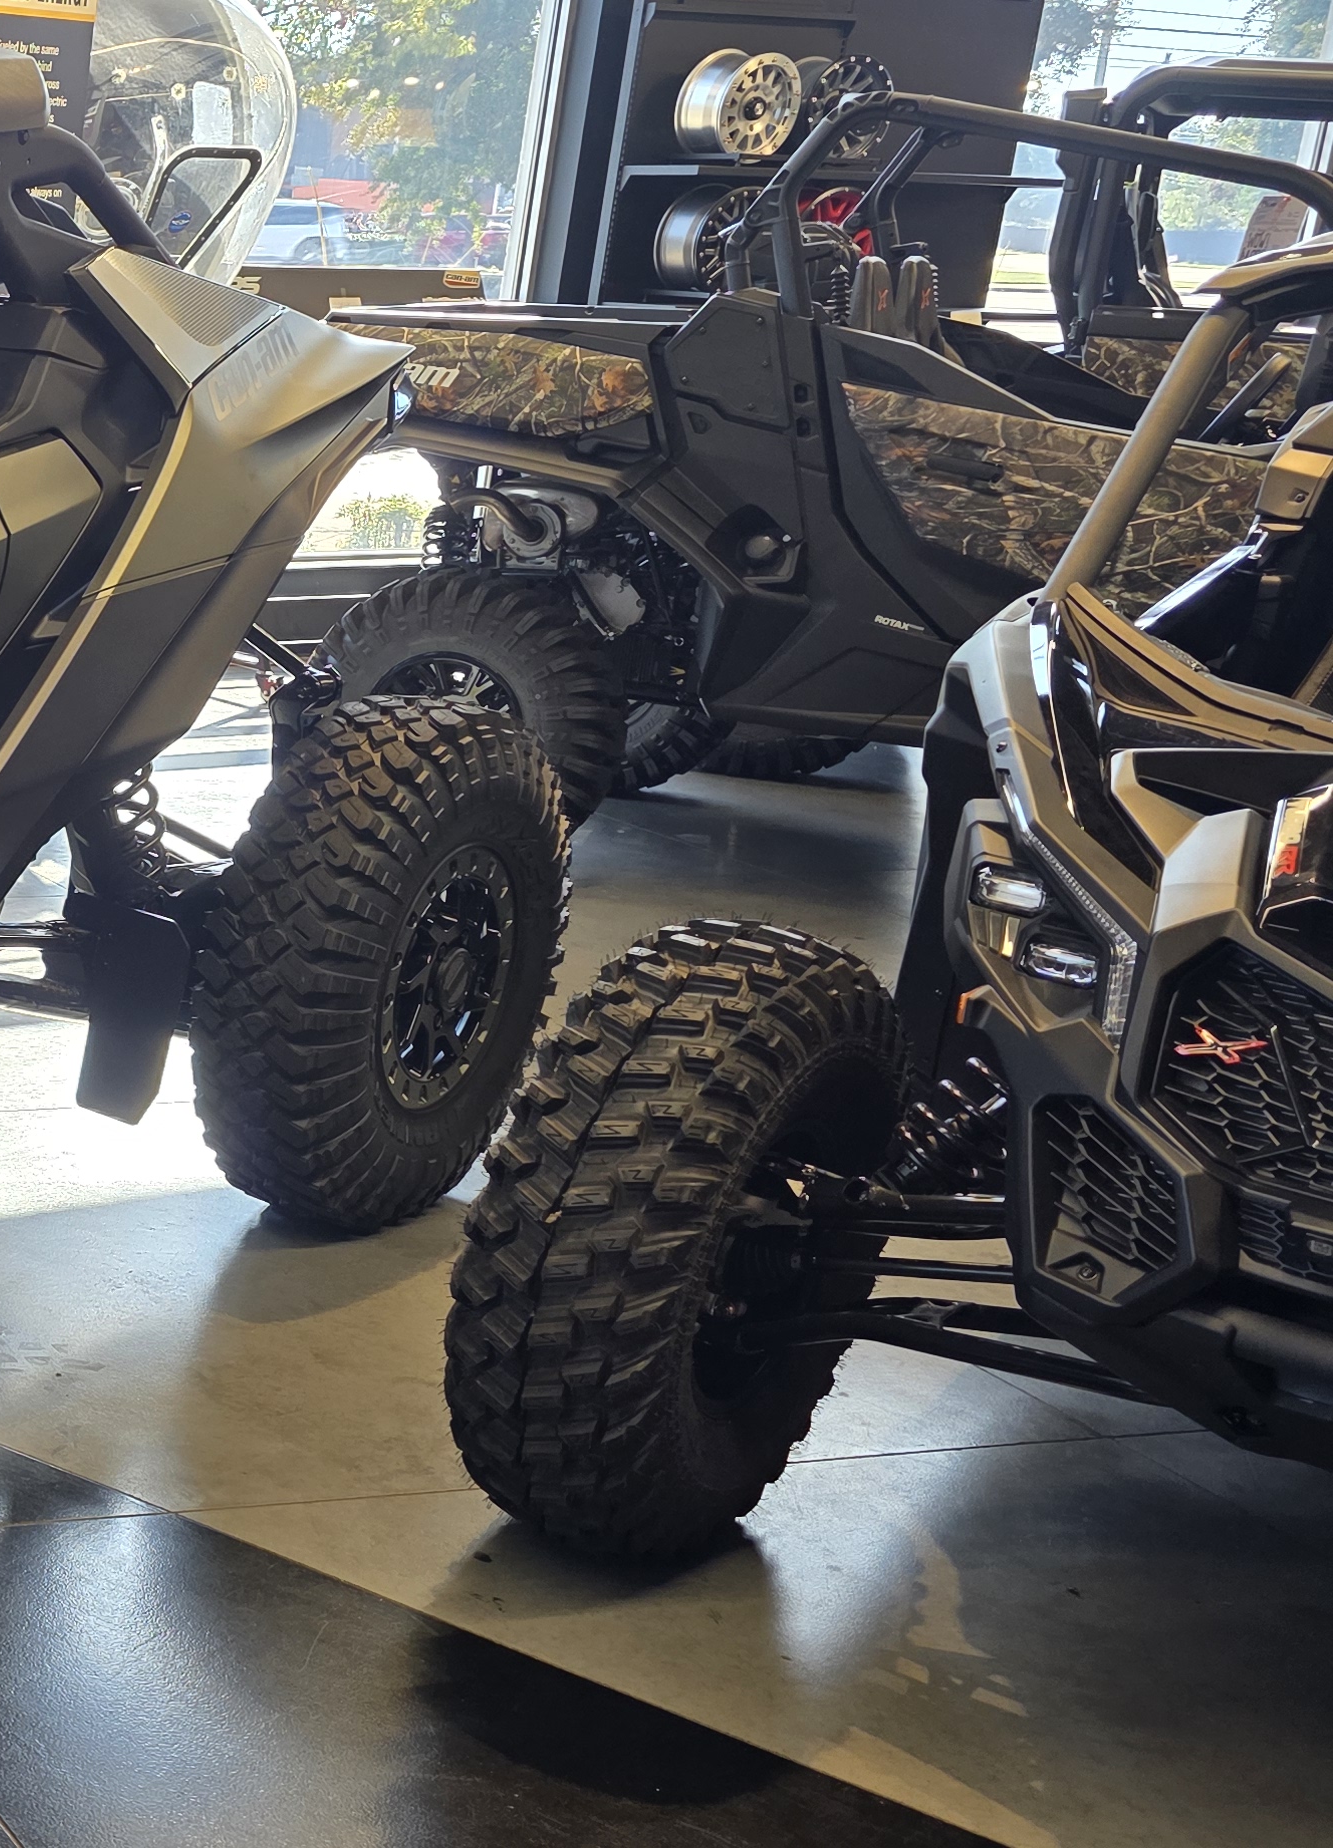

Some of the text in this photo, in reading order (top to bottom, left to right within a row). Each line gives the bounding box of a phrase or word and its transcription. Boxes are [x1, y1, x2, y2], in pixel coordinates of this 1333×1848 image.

[20, 42, 28, 54] by
[29, 43, 40, 54] the
[41, 46, 59, 55] same
[445, 272, 479, 284] can-am
[207, 319, 300, 421] can-am
[875, 615, 909, 630] ROTAX
